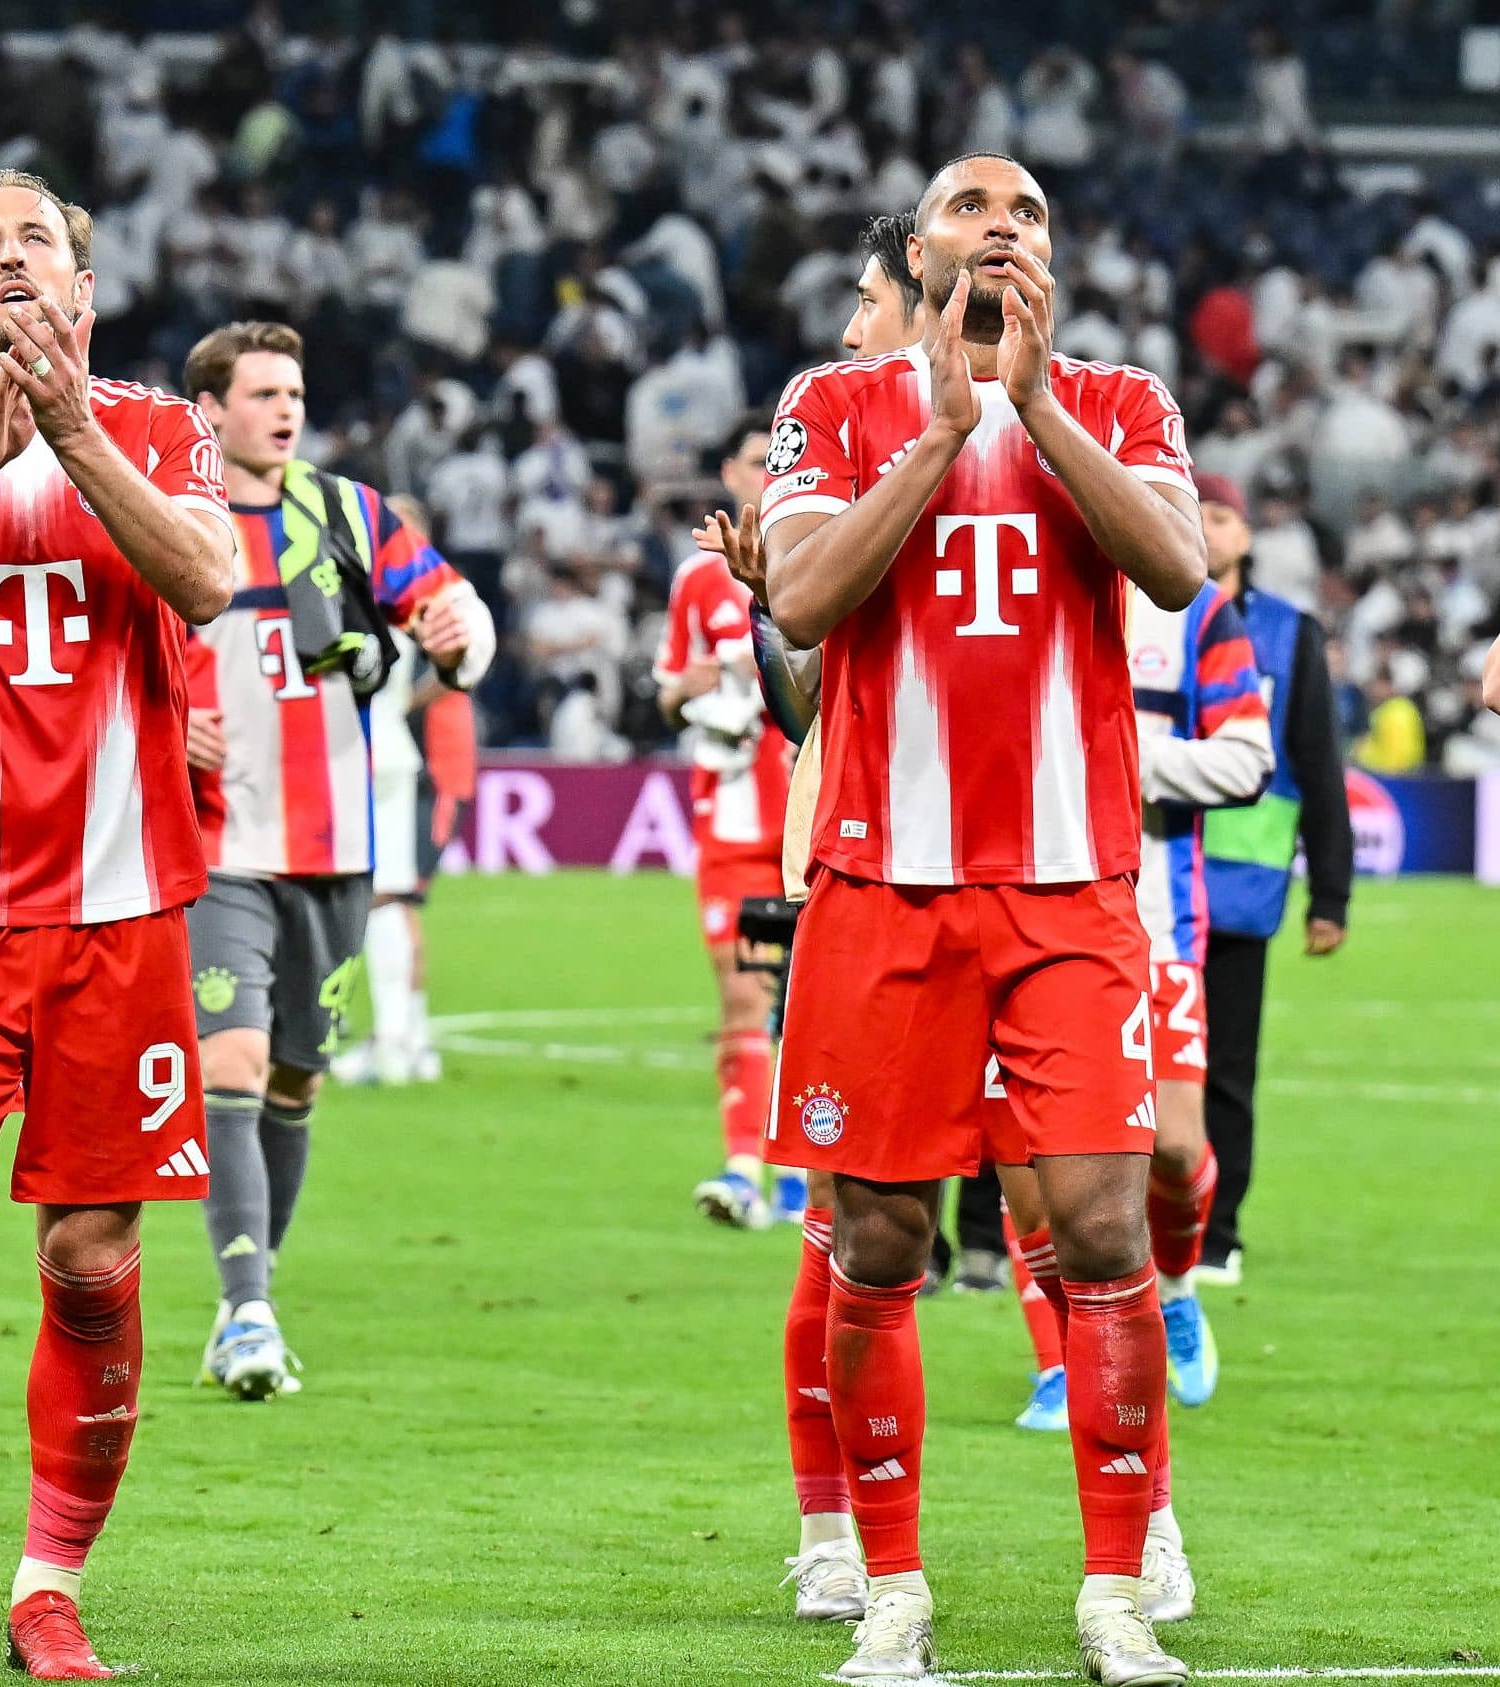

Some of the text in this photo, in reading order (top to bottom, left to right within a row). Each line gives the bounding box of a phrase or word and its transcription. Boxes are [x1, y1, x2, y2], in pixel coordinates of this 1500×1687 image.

[935, 513, 1038, 636] T
[1120, 990, 1153, 1080] 4
[138, 1041, 186, 1132] 9
[815, 1101, 840, 1121] BAYERN
